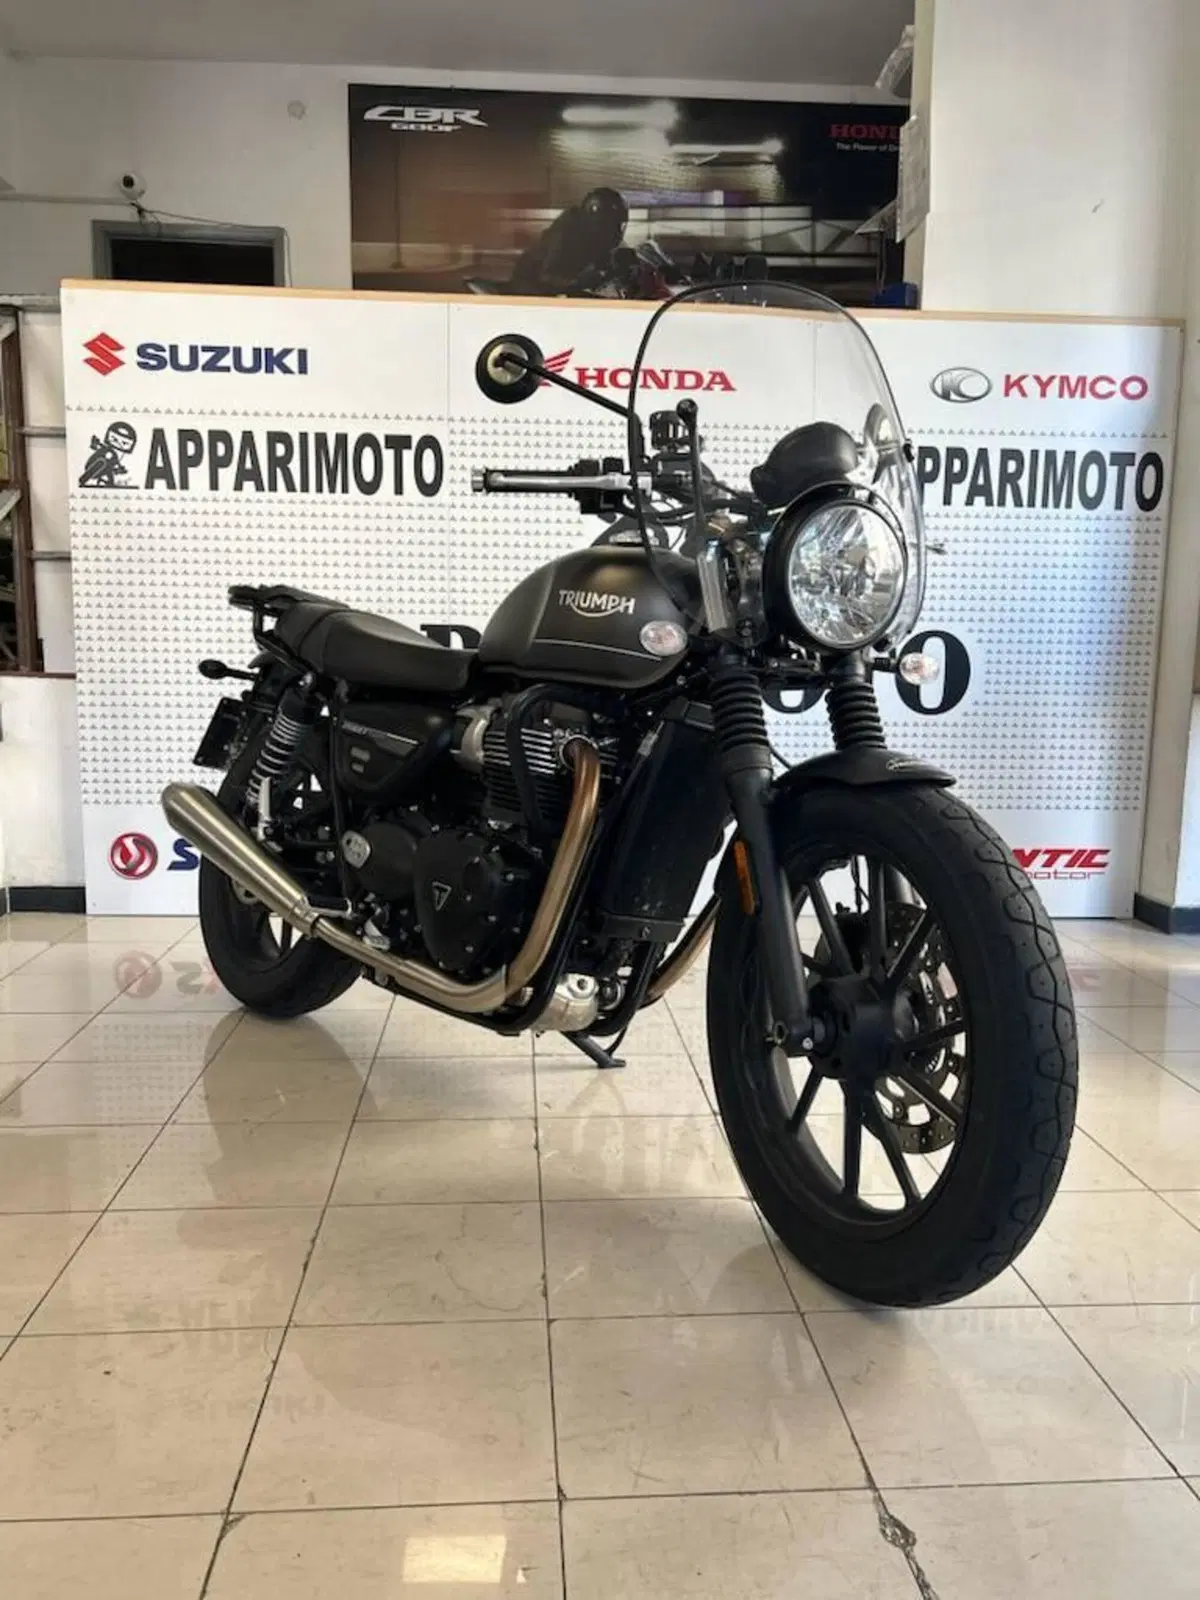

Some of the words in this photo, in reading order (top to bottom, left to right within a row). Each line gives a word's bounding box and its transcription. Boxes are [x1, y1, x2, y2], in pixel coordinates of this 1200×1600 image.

[363, 105, 488, 127] CBR
[828, 124, 900, 139] HON
[136, 343, 308, 375] SUZUKI
[574, 367, 737, 392] HONDA
[1003, 374, 1148, 400] KYMCO
[144, 428, 444, 497] APPARIMOTO
[917, 446, 1164, 512] PPARIMOTO
[559, 589, 636, 617] TRIUMPH
[1012, 849, 1111, 868] NTIC
